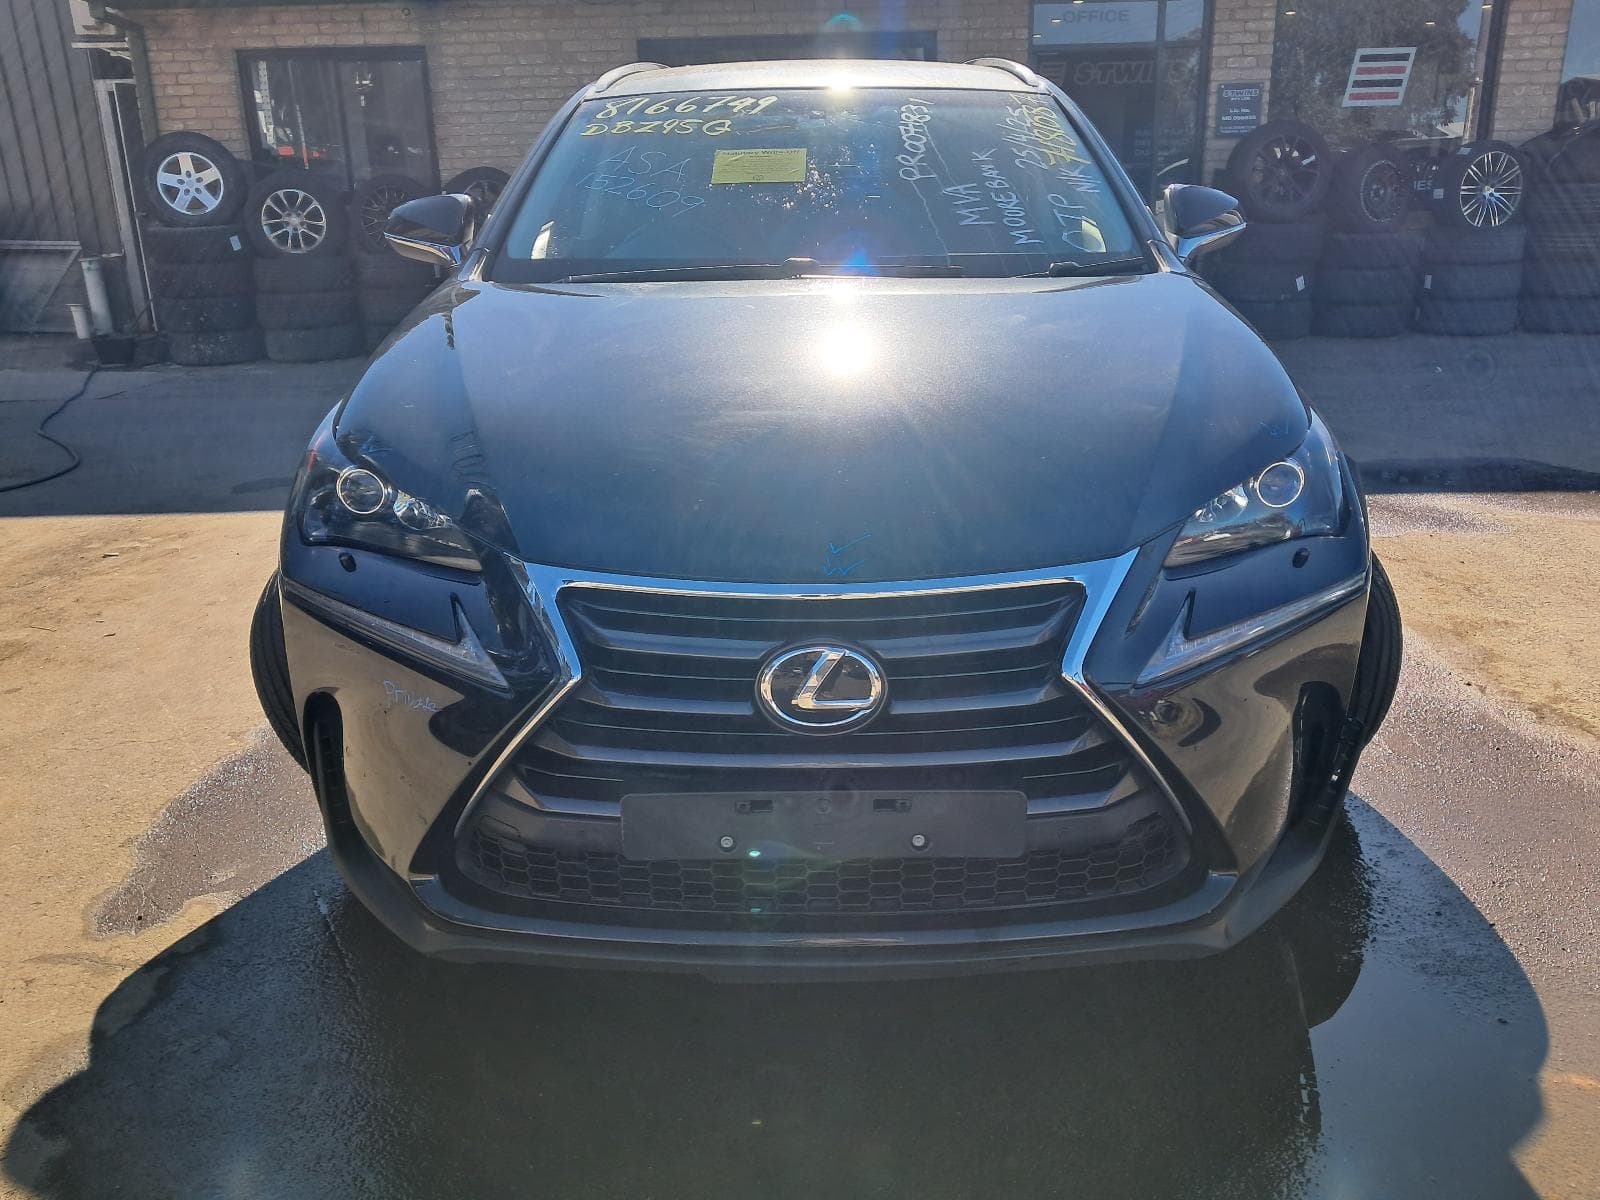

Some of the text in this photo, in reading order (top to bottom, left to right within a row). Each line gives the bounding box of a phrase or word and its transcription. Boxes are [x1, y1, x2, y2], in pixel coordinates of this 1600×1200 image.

[1062, 9, 1130, 24] OFFICE
[594, 145, 692, 182] ASA
[943, 182, 996, 226] MVA
